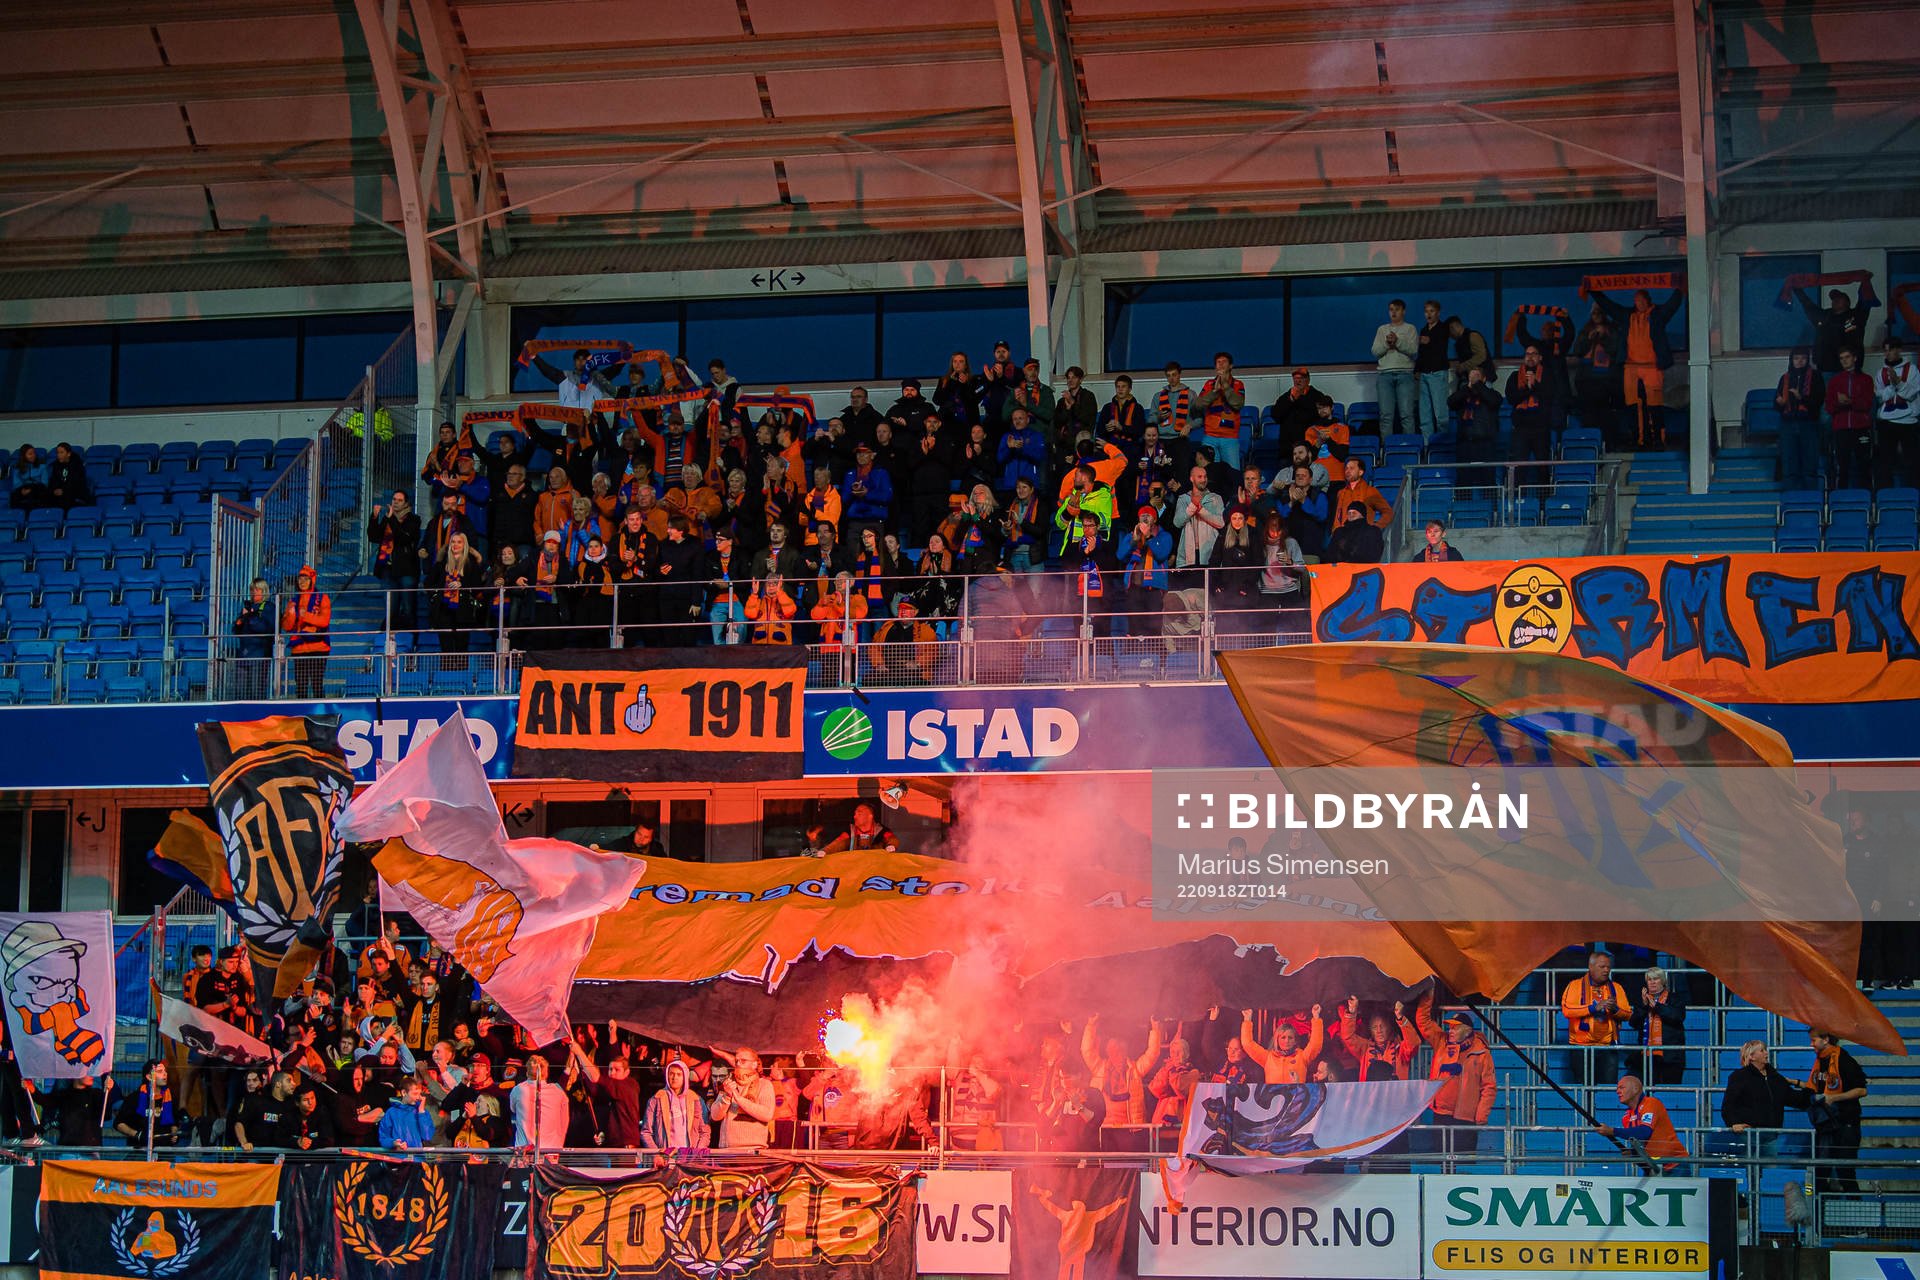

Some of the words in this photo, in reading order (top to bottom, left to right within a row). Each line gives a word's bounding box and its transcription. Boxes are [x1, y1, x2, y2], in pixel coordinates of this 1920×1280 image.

[769, 269, 788, 291] K
[681, 681, 793, 738] 1911
[887, 708, 1080, 761] ISTAD
[91, 807, 106, 833] J
[502, 802, 524, 829] K
[93, 1177, 218, 1198] AALESUNDS
[357, 1193, 425, 1223] 1848
[1445, 1186, 1698, 1227] SMART
[916, 1203, 1012, 1243] W.S
[1447, 1247, 1504, 1264] FLIS
[1518, 1247, 1554, 1264] OG
[1569, 1247, 1699, 1265] INTERIØR
